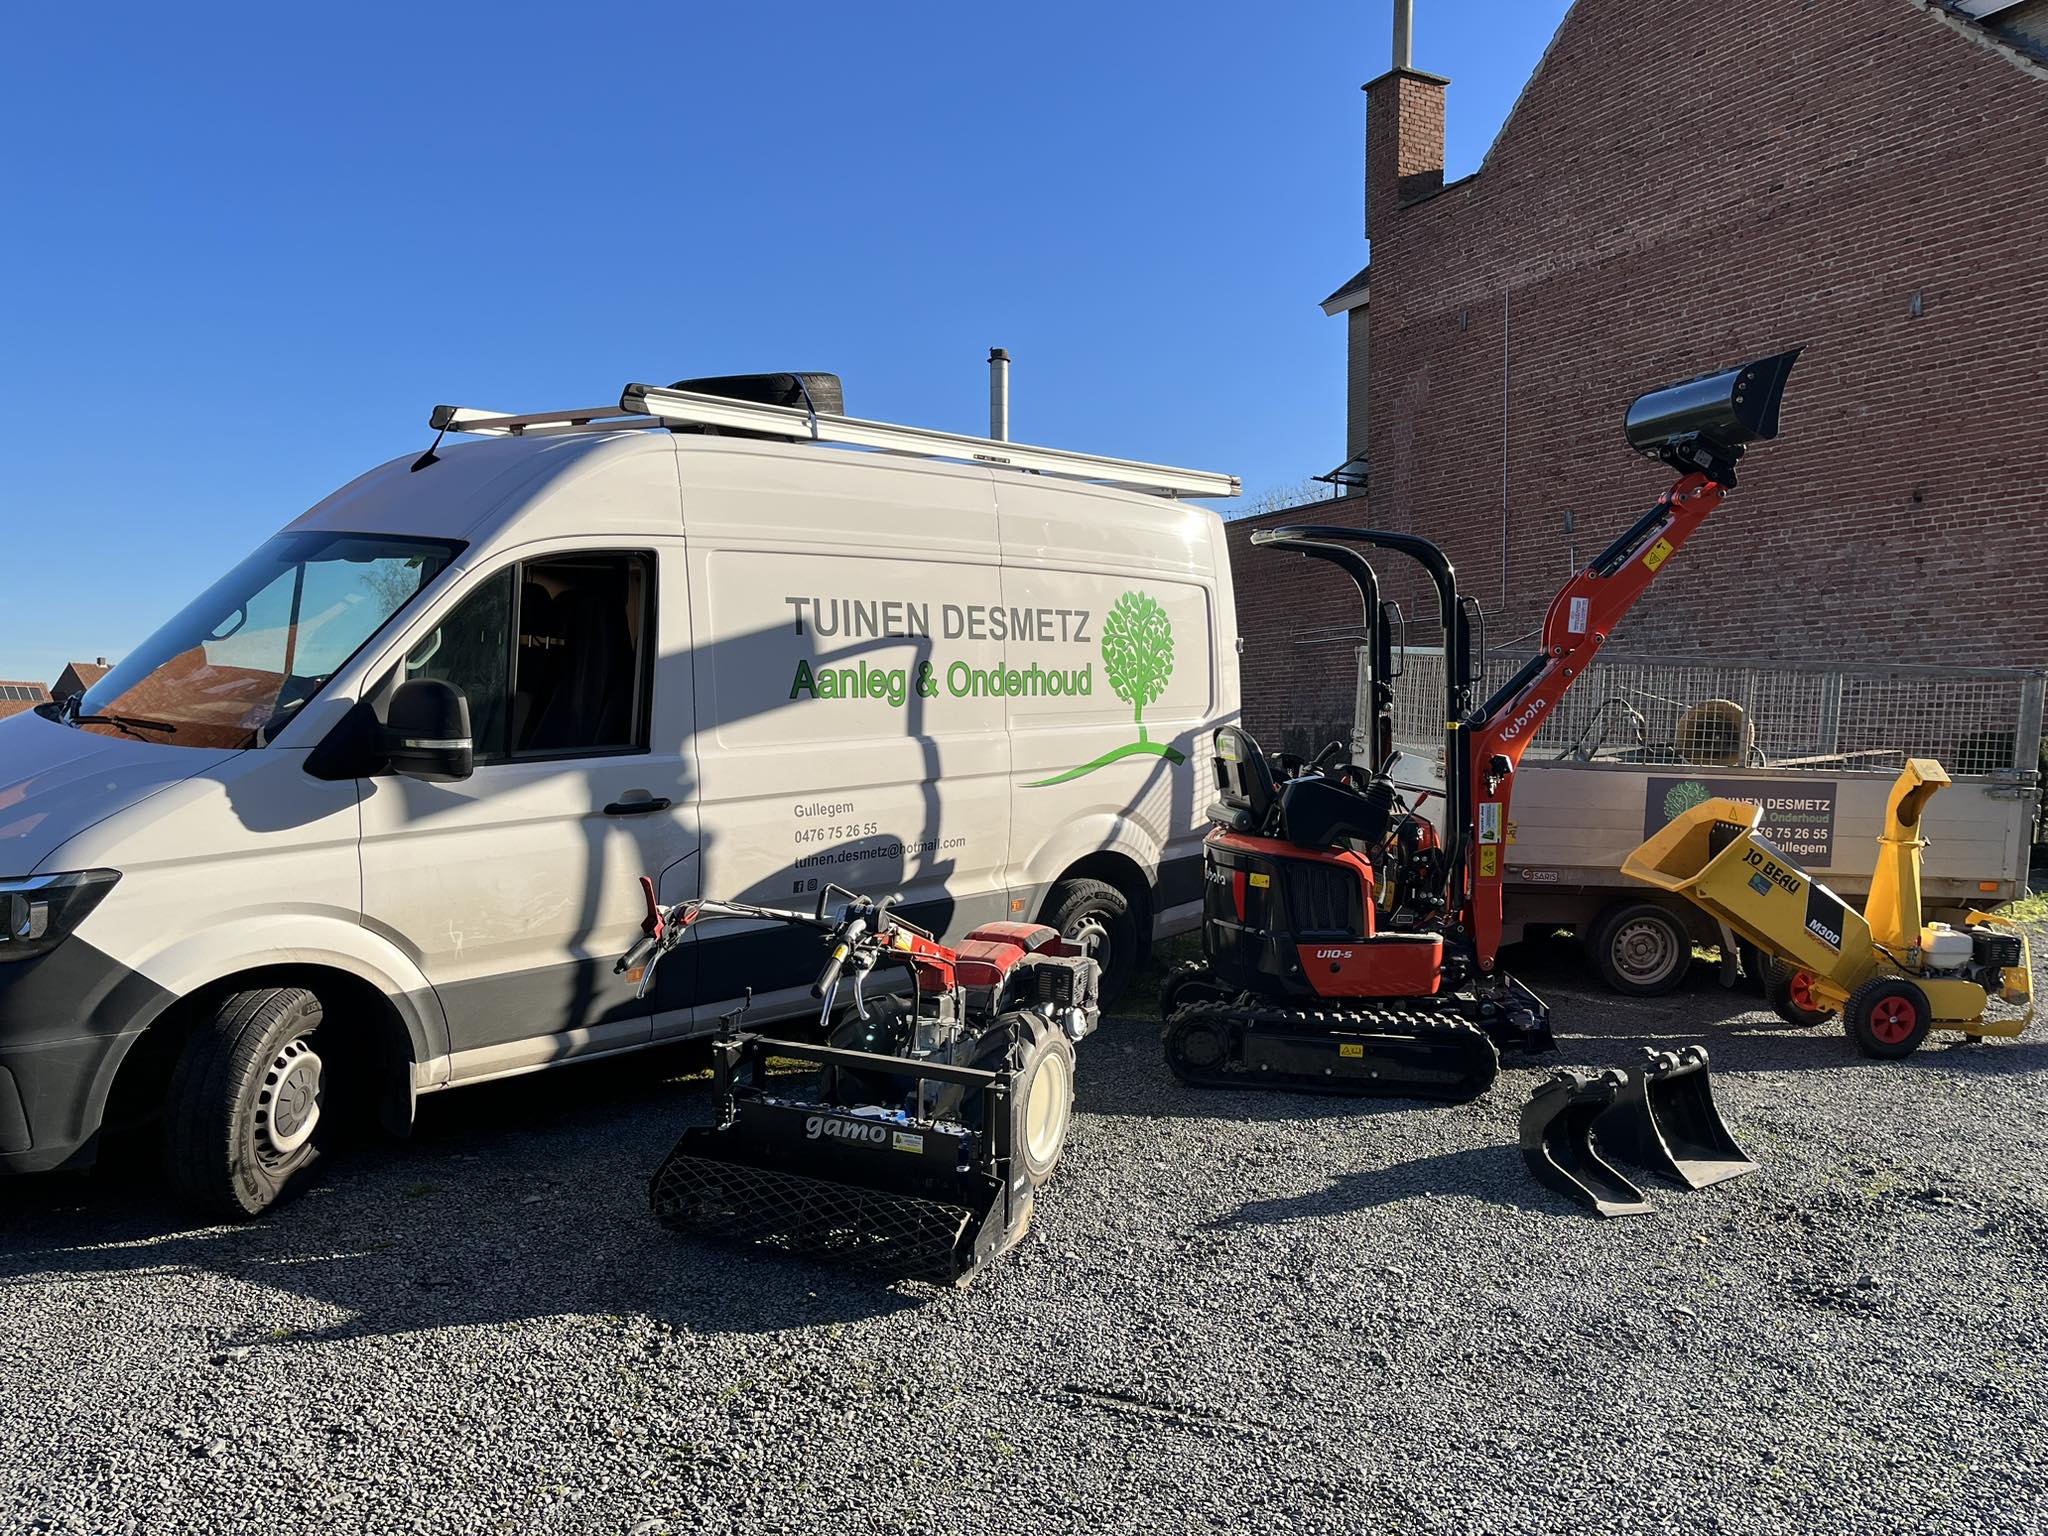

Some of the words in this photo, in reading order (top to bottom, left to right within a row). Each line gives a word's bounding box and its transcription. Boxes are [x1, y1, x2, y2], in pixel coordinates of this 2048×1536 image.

[785, 597, 929, 638] TUINEN
[942, 604, 1091, 642] DESMETZ
[789, 660, 906, 707] Aanleg
[916, 660, 939, 698] &
[947, 661, 1092, 698] Onderhoud
[1499, 699, 1546, 741] Kubota
[794, 802, 854, 818] Gullegem
[1767, 798, 1831, 811] DESMETZ
[1770, 812, 1830, 823] Onderhoud
[794, 828, 825, 843] 0476
[828, 826, 842, 839] 75
[846, 824, 860, 838] 26
[863, 822, 878, 835] 55
[1758, 827, 1773, 838] 76
[1776, 827, 1791, 838] 75
[1794, 828, 1809, 839] 26
[1813, 828, 1828, 840] 55
[794, 837, 966, 869] tuinen.desmetz@hotmail.com
[1534, 871, 1558, 881] SARIS
[1742, 848, 1764, 866] JO
[1762, 861, 1801, 893] BEAU
[1809, 919, 1840, 944] M300
[805, 1116, 886, 1143] gamo
